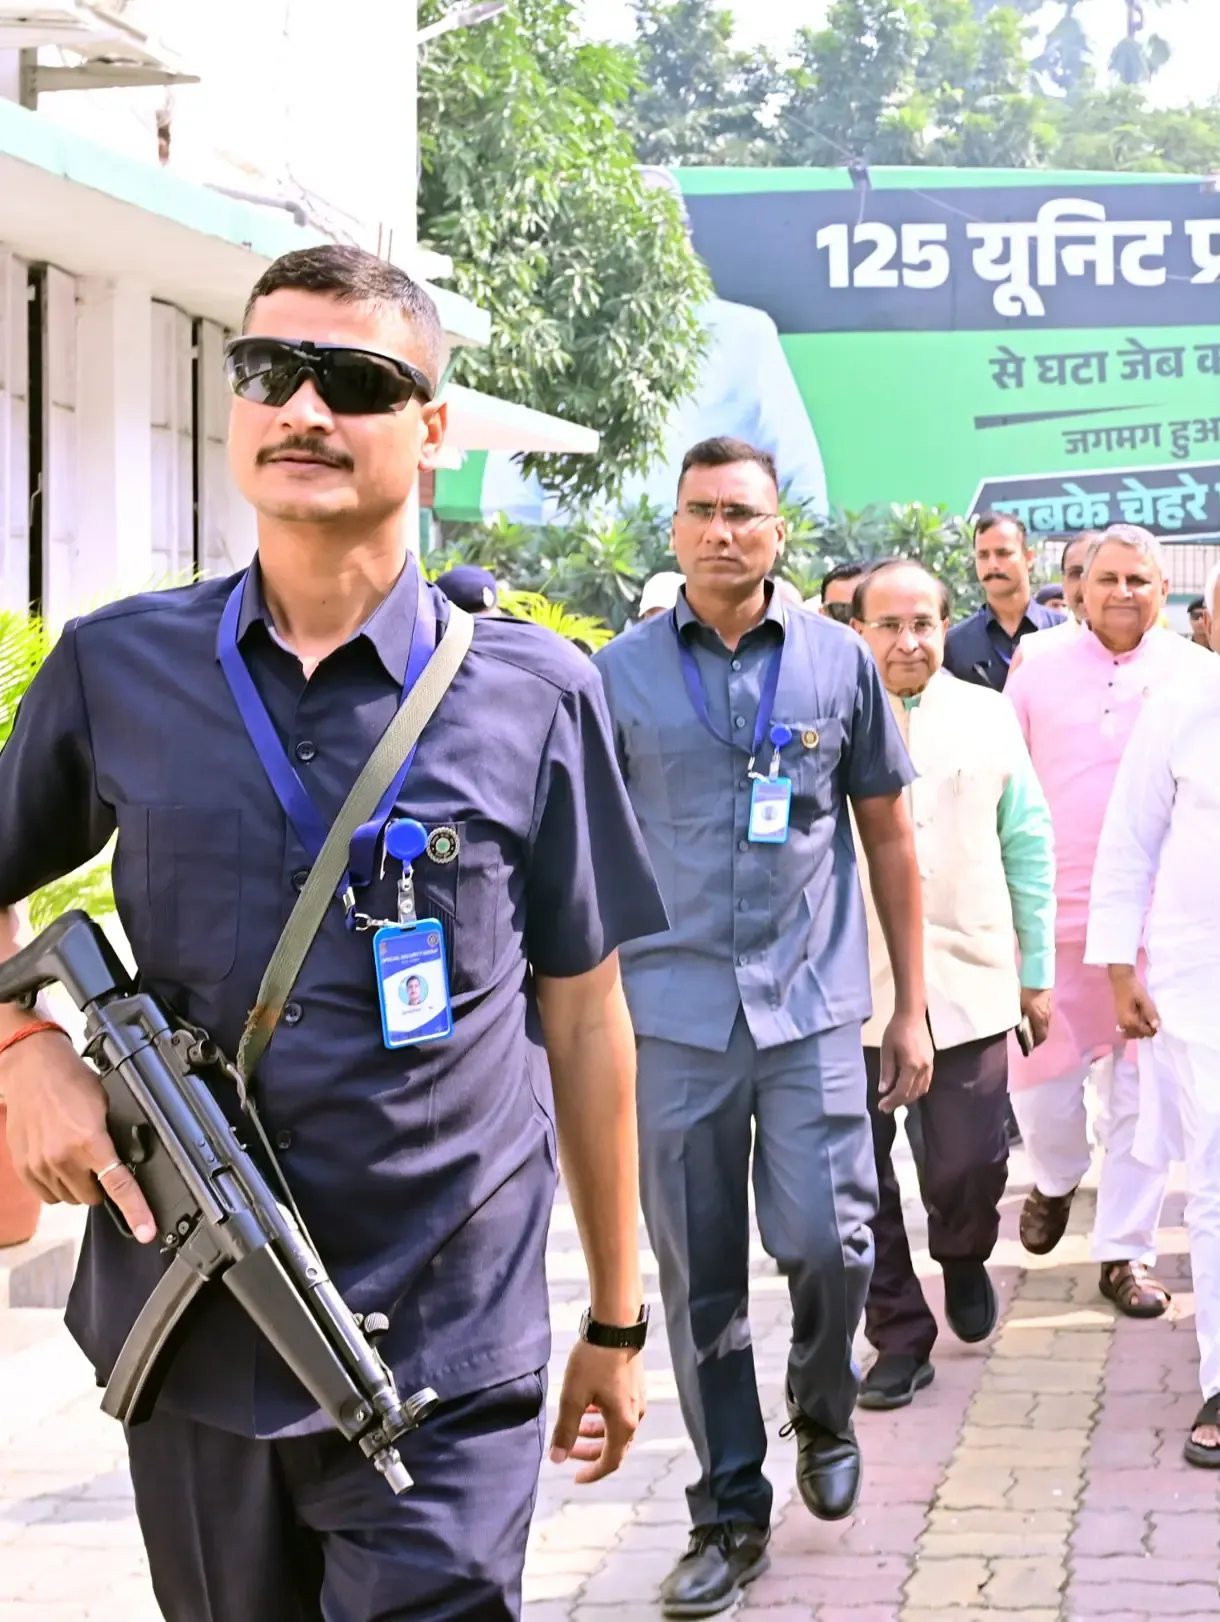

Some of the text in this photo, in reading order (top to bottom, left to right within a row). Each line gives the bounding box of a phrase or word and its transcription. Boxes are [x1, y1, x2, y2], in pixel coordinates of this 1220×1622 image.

[816, 222, 950, 288] 125
[966, 198, 1172, 316] यूनिट
[989, 346, 1025, 388] से
[1034, 351, 1108, 386] घटा
[1117, 338, 1185, 380] जेब
[1062, 424, 1161, 456] जगमग
[1116, 474, 1209, 530] चेहरे
